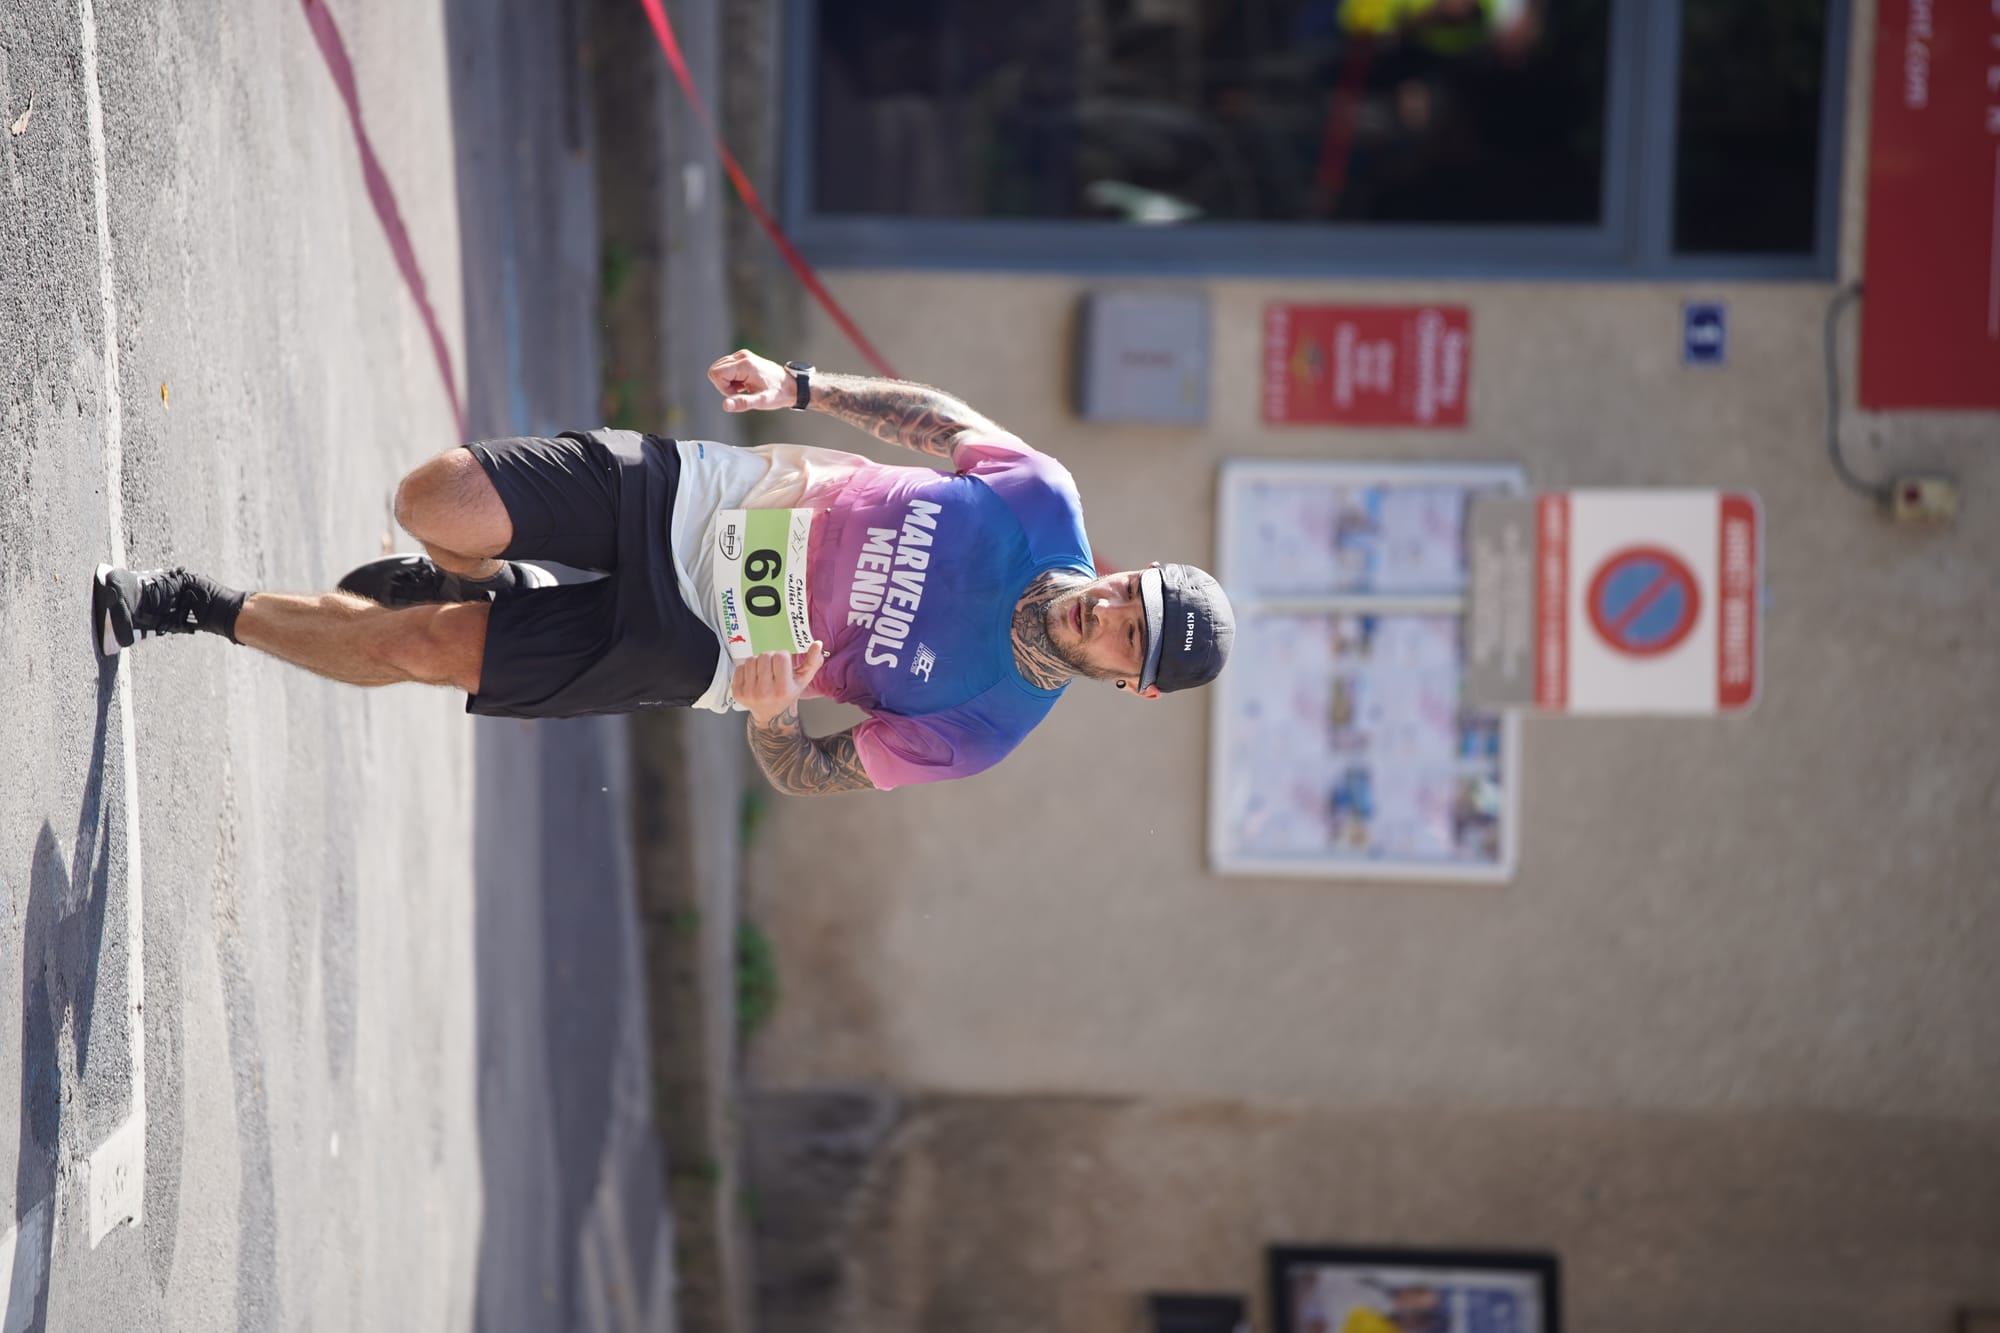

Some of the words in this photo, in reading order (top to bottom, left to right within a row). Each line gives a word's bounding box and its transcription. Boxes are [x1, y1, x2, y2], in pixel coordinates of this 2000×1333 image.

[726, 524, 736, 555] BFP
[744, 548, 782, 617] 60
[847, 527, 897, 629] MENDE
[865, 498, 942, 669] MARVEJOLS
[721, 592, 732, 636] Aventure
[726, 587, 739, 631] TUFF'S
[795, 578, 805, 627] Challenge
[1184, 612, 1195, 651] KIPRUN
